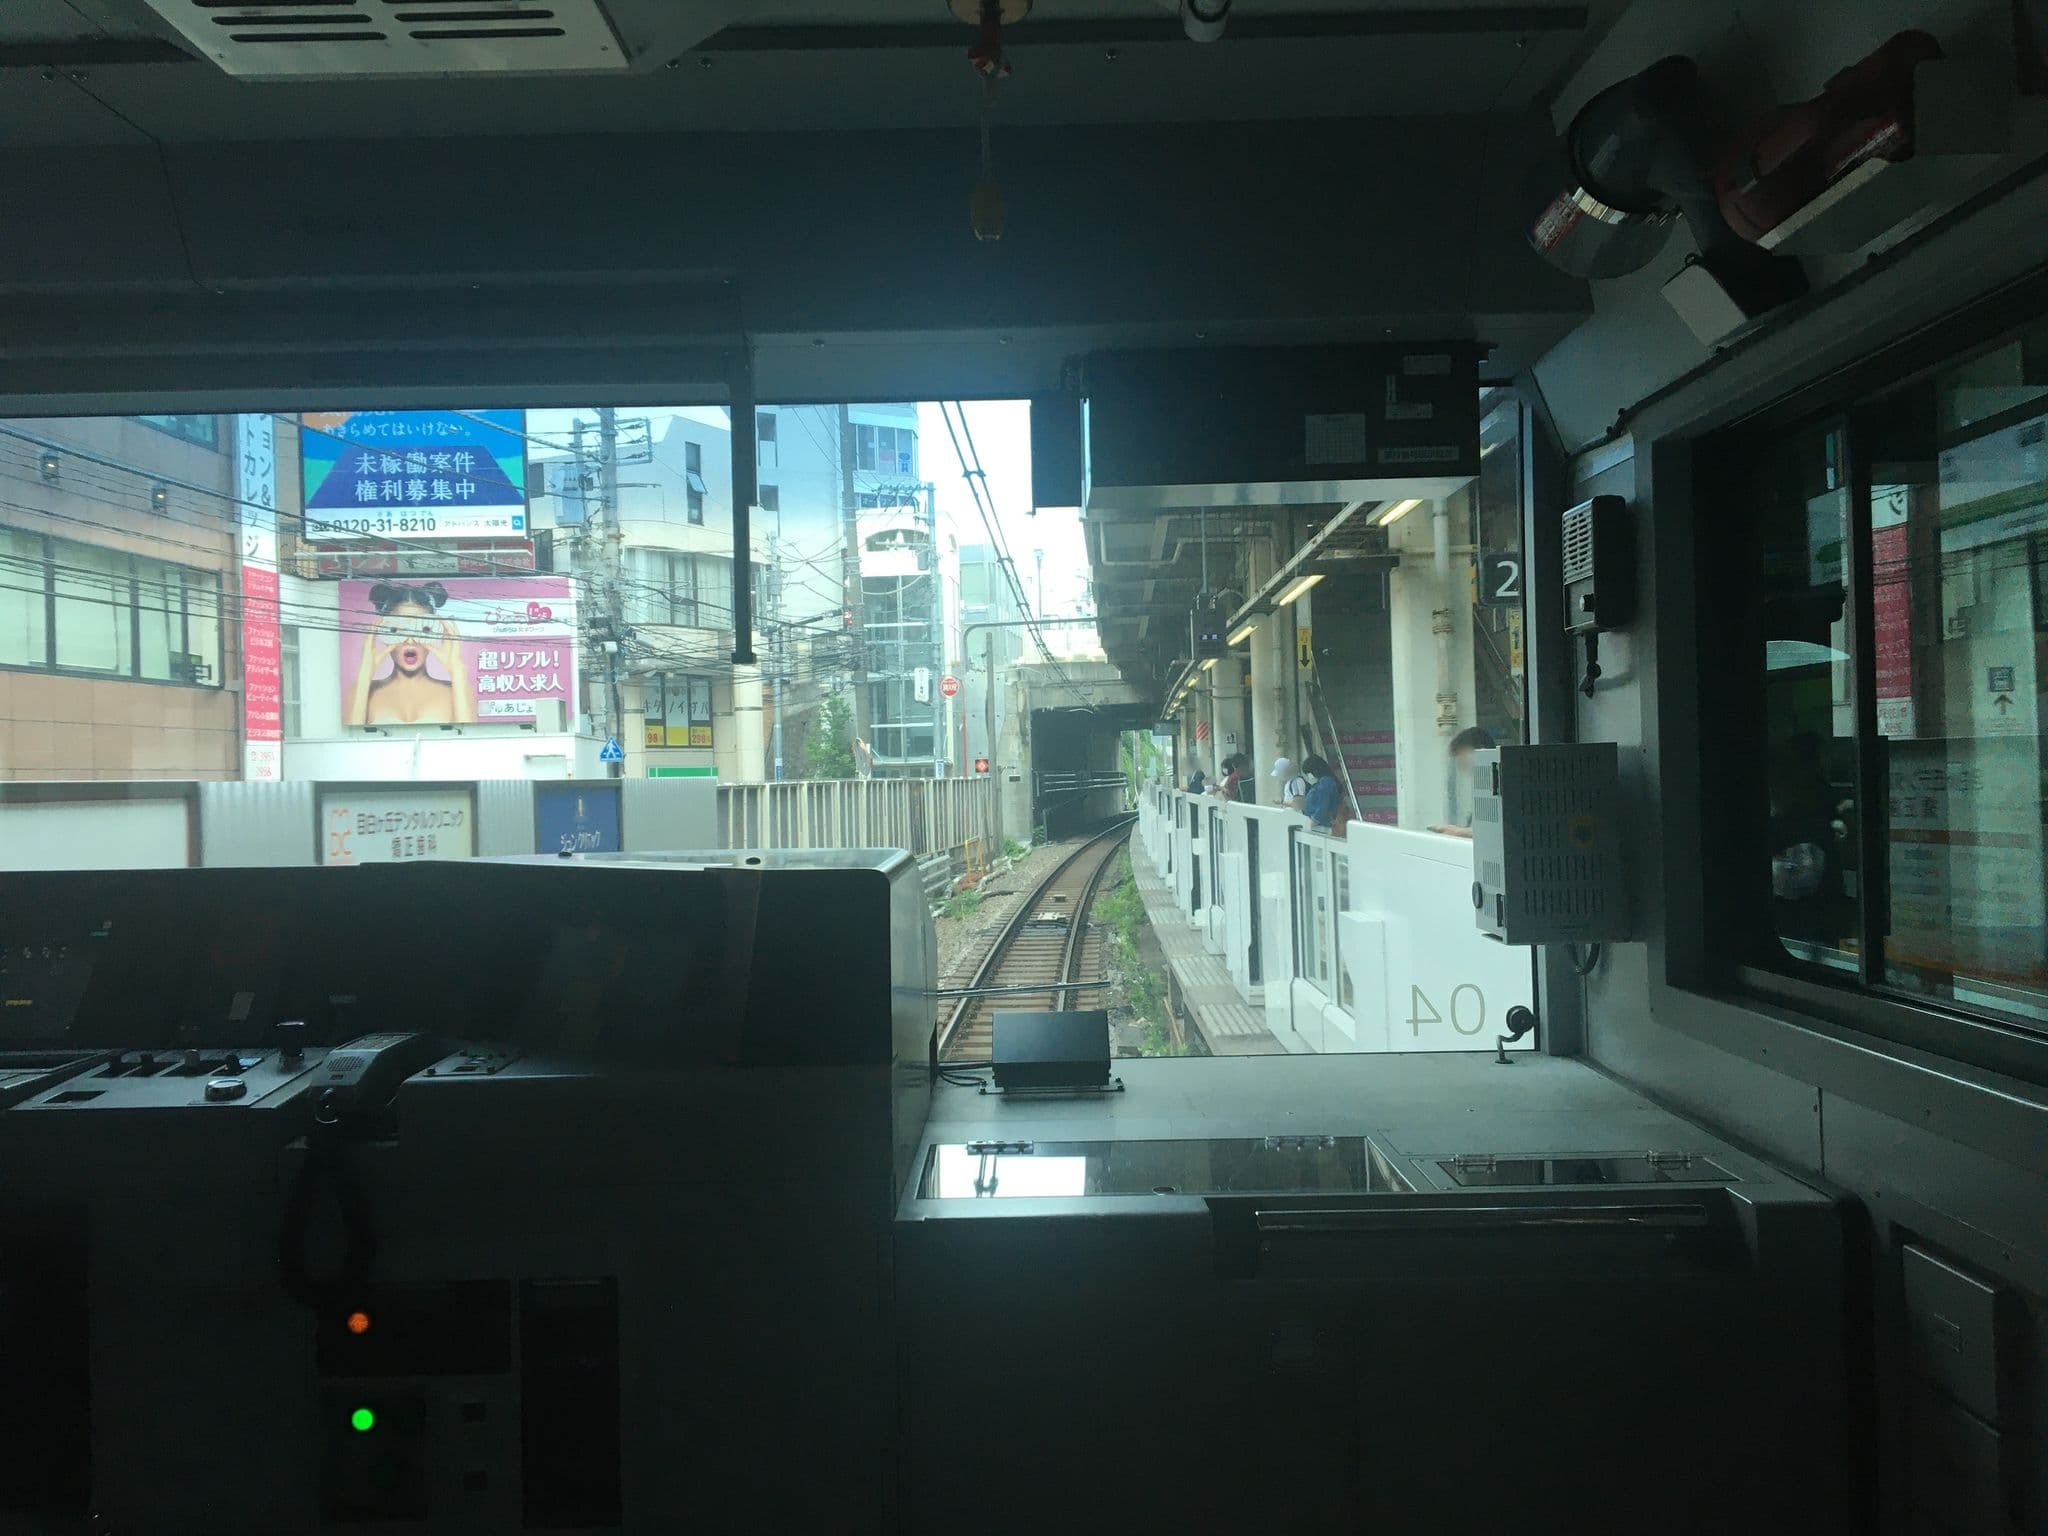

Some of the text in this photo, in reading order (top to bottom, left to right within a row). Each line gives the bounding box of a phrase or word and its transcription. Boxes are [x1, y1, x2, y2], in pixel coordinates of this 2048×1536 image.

[355, 479, 477, 502] 権利募集中
[333, 518, 436, 534] 0120-31-8210
[1495, 560, 1521, 597] 2
[478, 673, 564, 693] 高収入求人
